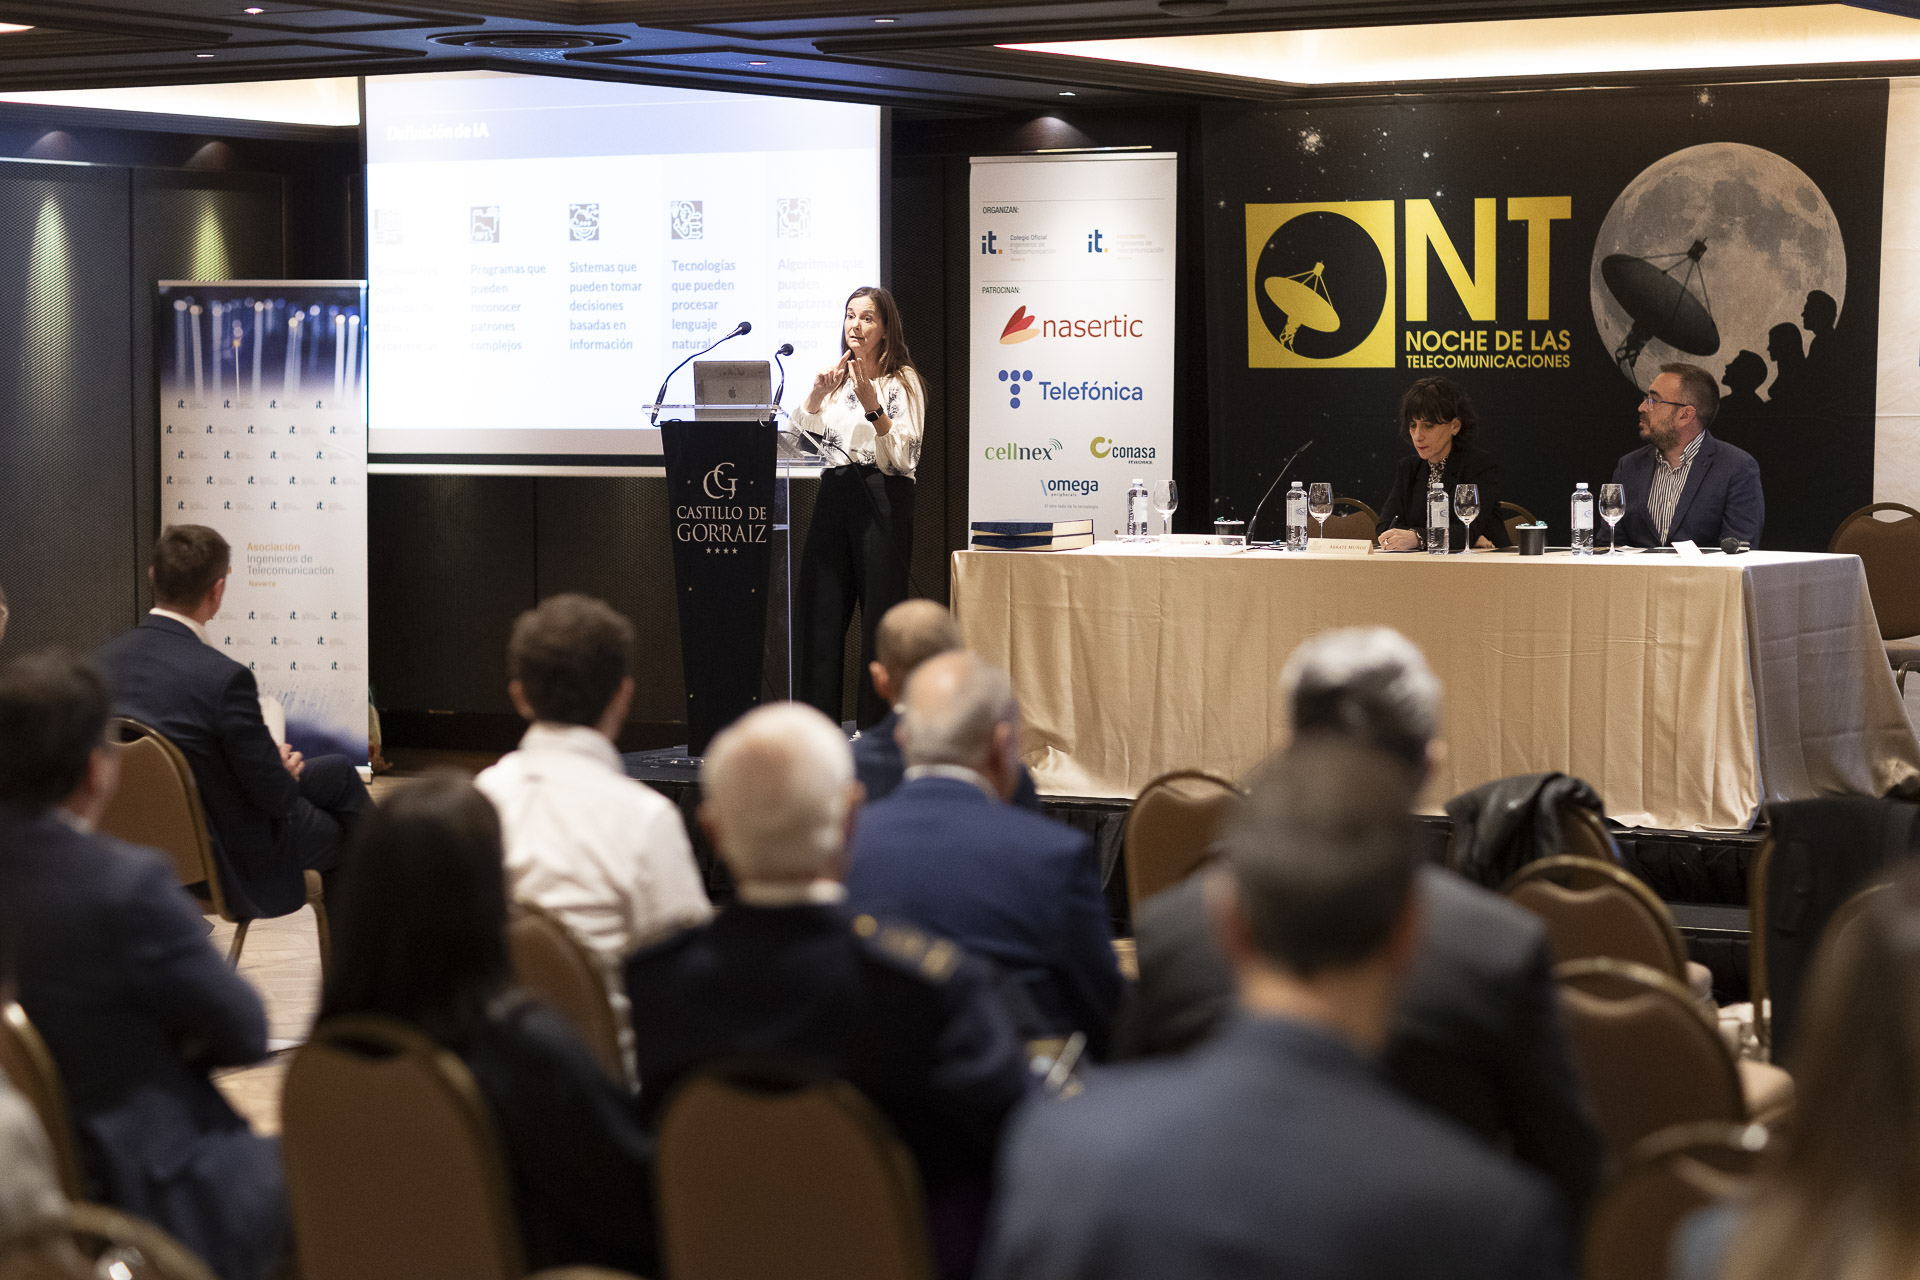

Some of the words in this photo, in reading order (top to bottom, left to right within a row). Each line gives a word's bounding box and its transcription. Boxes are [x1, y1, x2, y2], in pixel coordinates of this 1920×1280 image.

[455, 122, 472, 139] de
[473, 121, 490, 138] IA
[982, 206, 1020, 214] ORGANIZAN:
[1010, 234, 1030, 242] Colegio
[470, 263, 525, 277] Programas
[527, 265, 546, 277] que
[569, 261, 615, 274] Sistemas
[617, 264, 637, 277] que
[671, 259, 736, 274] Tecnologías
[777, 258, 840, 273] Algoritmos
[842, 260, 864, 273] que
[470, 283, 509, 296] pueden
[569, 280, 609, 295] pueden
[610, 281, 643, 293] tomar
[671, 281, 692, 294] que
[694, 279, 735, 293] pueden
[777, 278, 820, 292] pueden
[981, 286, 1021, 294] PATROCINAN:
[470, 302, 522, 313] reconocer
[569, 298, 624, 312] decisiones
[671, 300, 719, 314] procesar
[777, 297, 834, 312] adaptarse
[470, 321, 516, 334] patrones
[569, 318, 611, 331] basadas
[613, 321, 626, 331] en
[671, 317, 718, 332] lenguaje
[777, 317, 823, 332] mejorar
[1042, 314, 1143, 338] nasertic
[470, 340, 523, 353] complejos
[569, 337, 633, 351] información
[671, 337, 712, 350] natural
[1405, 330, 1488, 352] NOCHE
[1495, 330, 1523, 352] DE
[1530, 329, 1571, 351] LAS
[1406, 354, 1571, 369] TELECOMUNICACIONES
[1039, 381, 1143, 401] Telefónica
[984, 442, 1053, 461] cellnex
[1112, 446, 1156, 459] conasa
[1048, 479, 1099, 495] omega
[676, 505, 743, 520] CASTILLO
[748, 506, 767, 520] DE
[676, 523, 767, 543] GORRAIZ
[247, 554, 298, 565] Ingenieros
[300, 554, 313, 563] de
[248, 565, 335, 575] Telecomunicación
